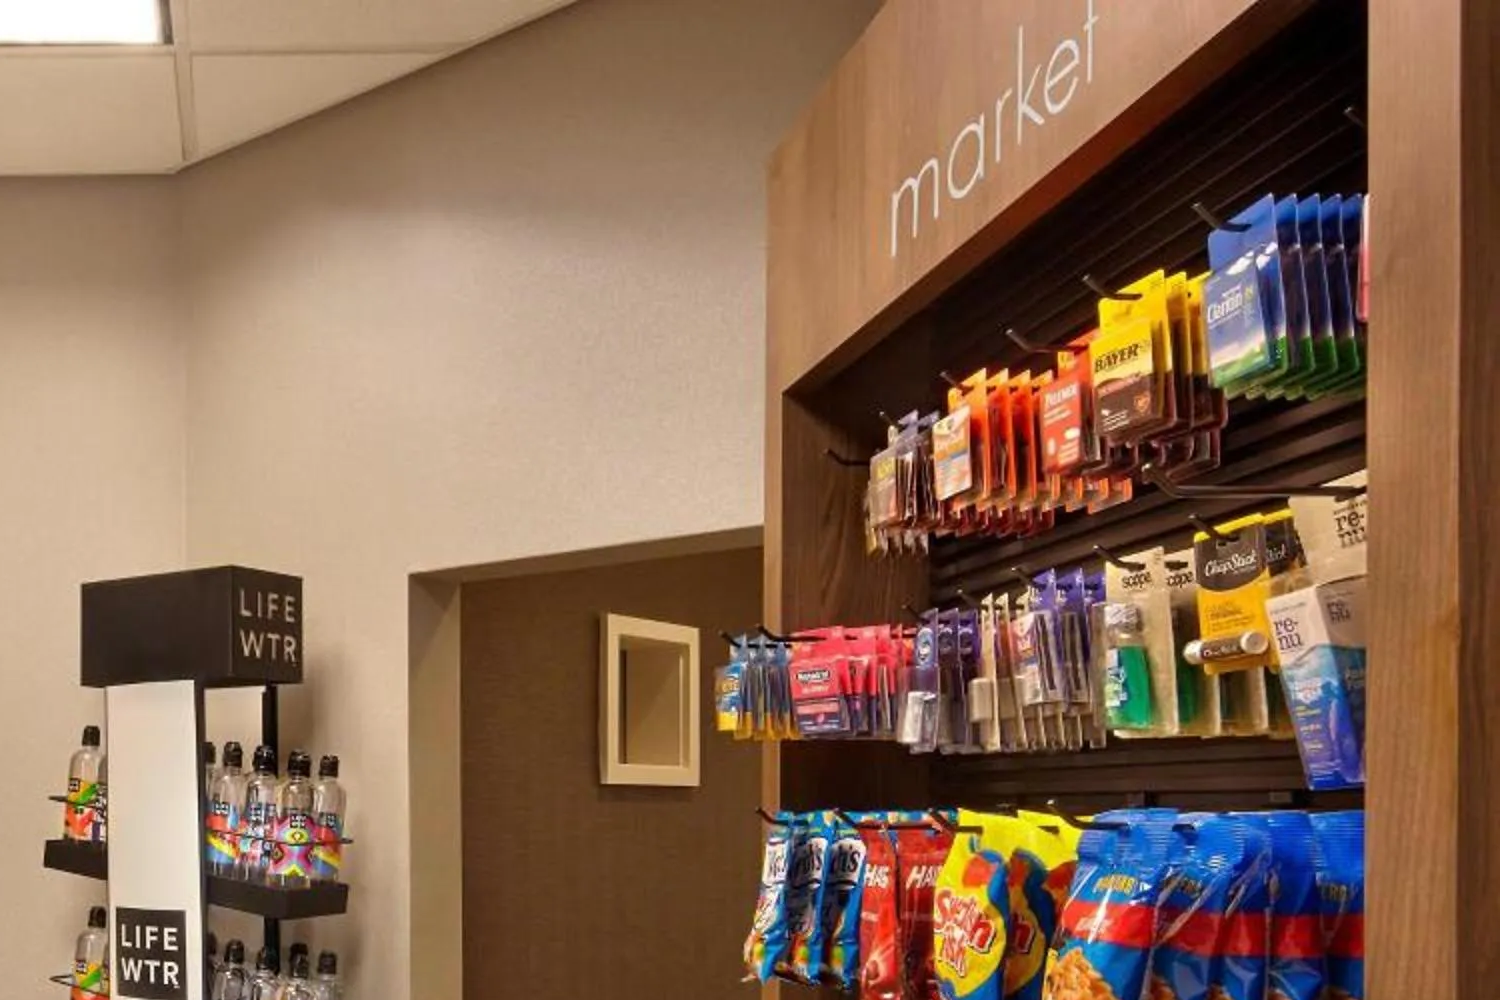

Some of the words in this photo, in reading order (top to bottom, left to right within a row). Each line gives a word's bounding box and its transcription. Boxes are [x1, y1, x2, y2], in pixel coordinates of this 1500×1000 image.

[891, 0, 1099, 257] market
[239, 587, 296, 623] LIFE
[239, 629, 297, 663] WTR
[121, 923, 178, 951] LIFE
[121, 957, 179, 985] WTR
